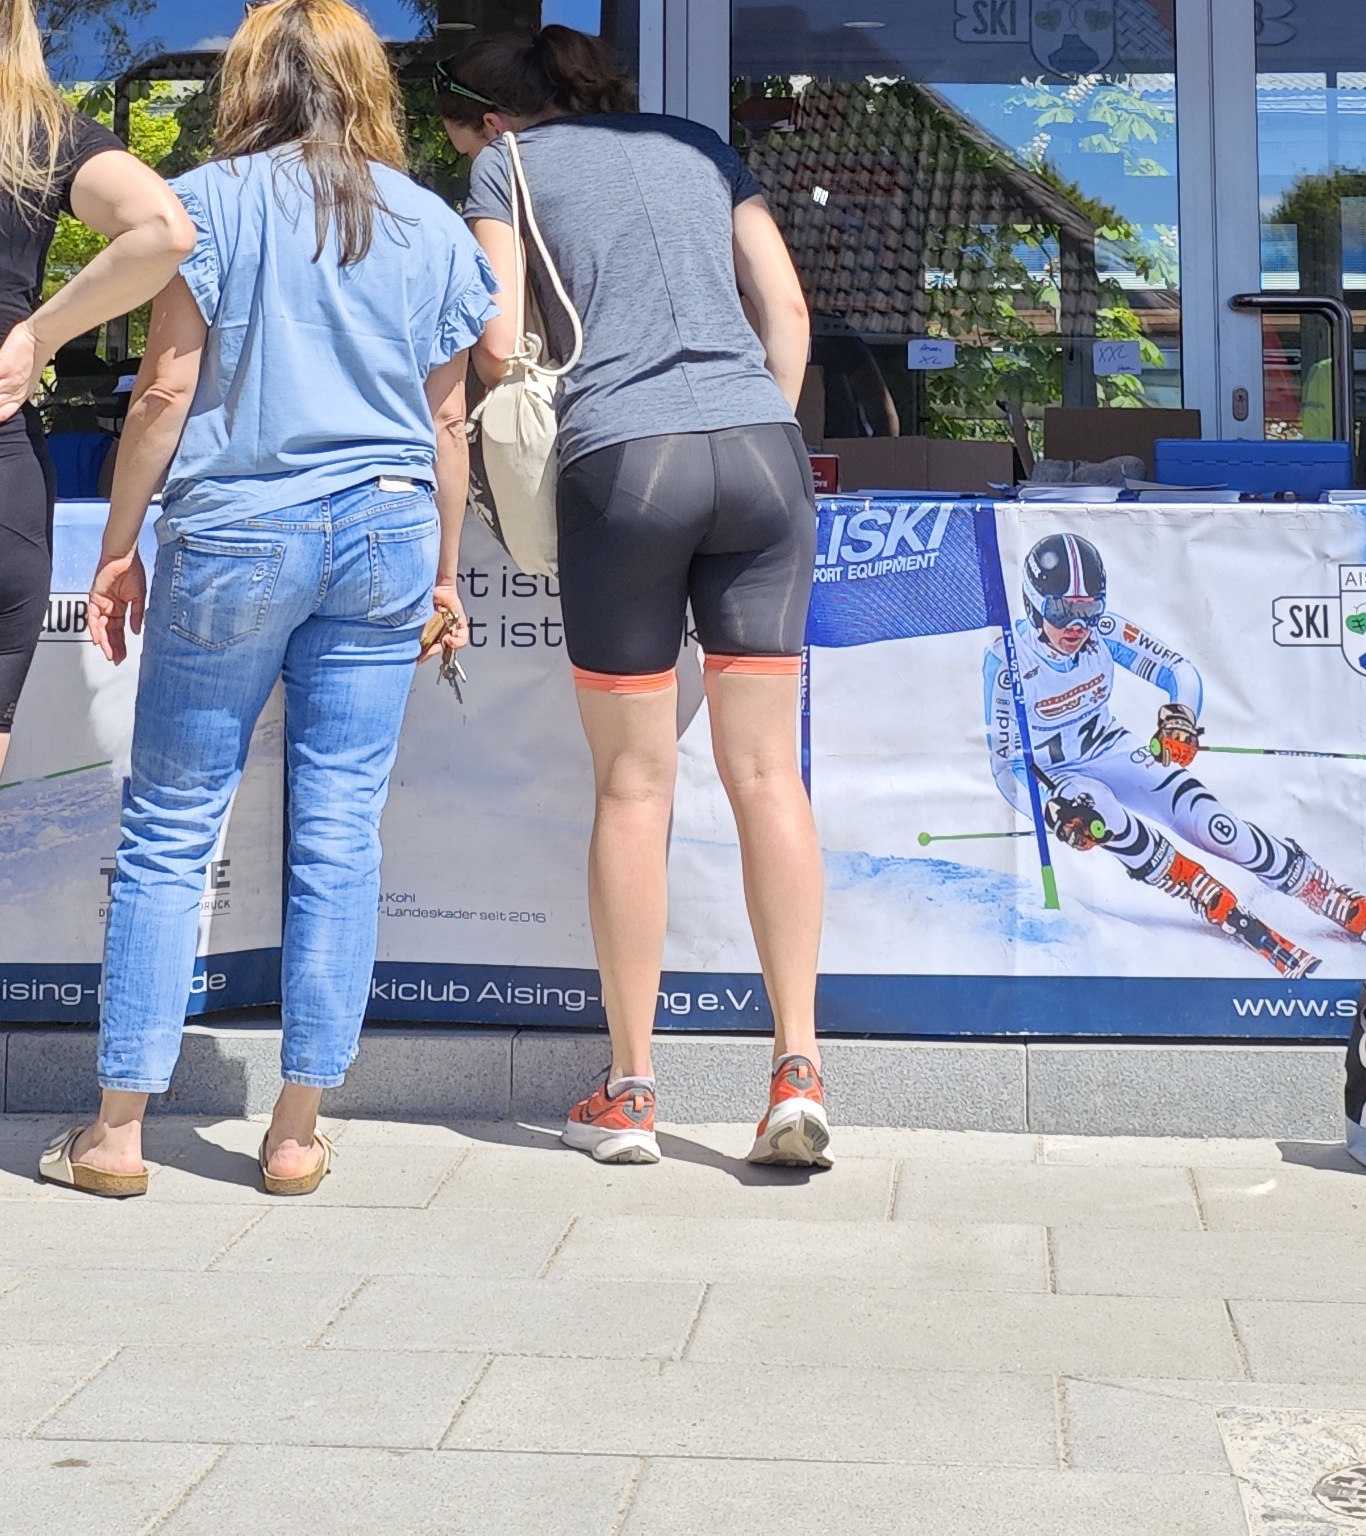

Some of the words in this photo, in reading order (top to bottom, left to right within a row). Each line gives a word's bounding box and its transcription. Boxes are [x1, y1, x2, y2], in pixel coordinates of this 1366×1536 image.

[813, 566, 844, 583] PORT
[847, 551, 940, 580] EQUIPMENT
[41, 600, 89, 634] LUB
[500, 615, 563, 648] ist
[1289, 604, 1329, 638] SKI
[995, 708, 1010, 759] Audi
[377, 906, 478, 920] -Landeskader
[480, 911, 506, 921] seit
[508, 912, 546, 924] 2016
[370, 978, 470, 1003] kiclub
[476, 980, 691, 1015] Aising-ng
[698, 989, 760, 1012] e.V.
[1233, 997, 1357, 1019] www.s
